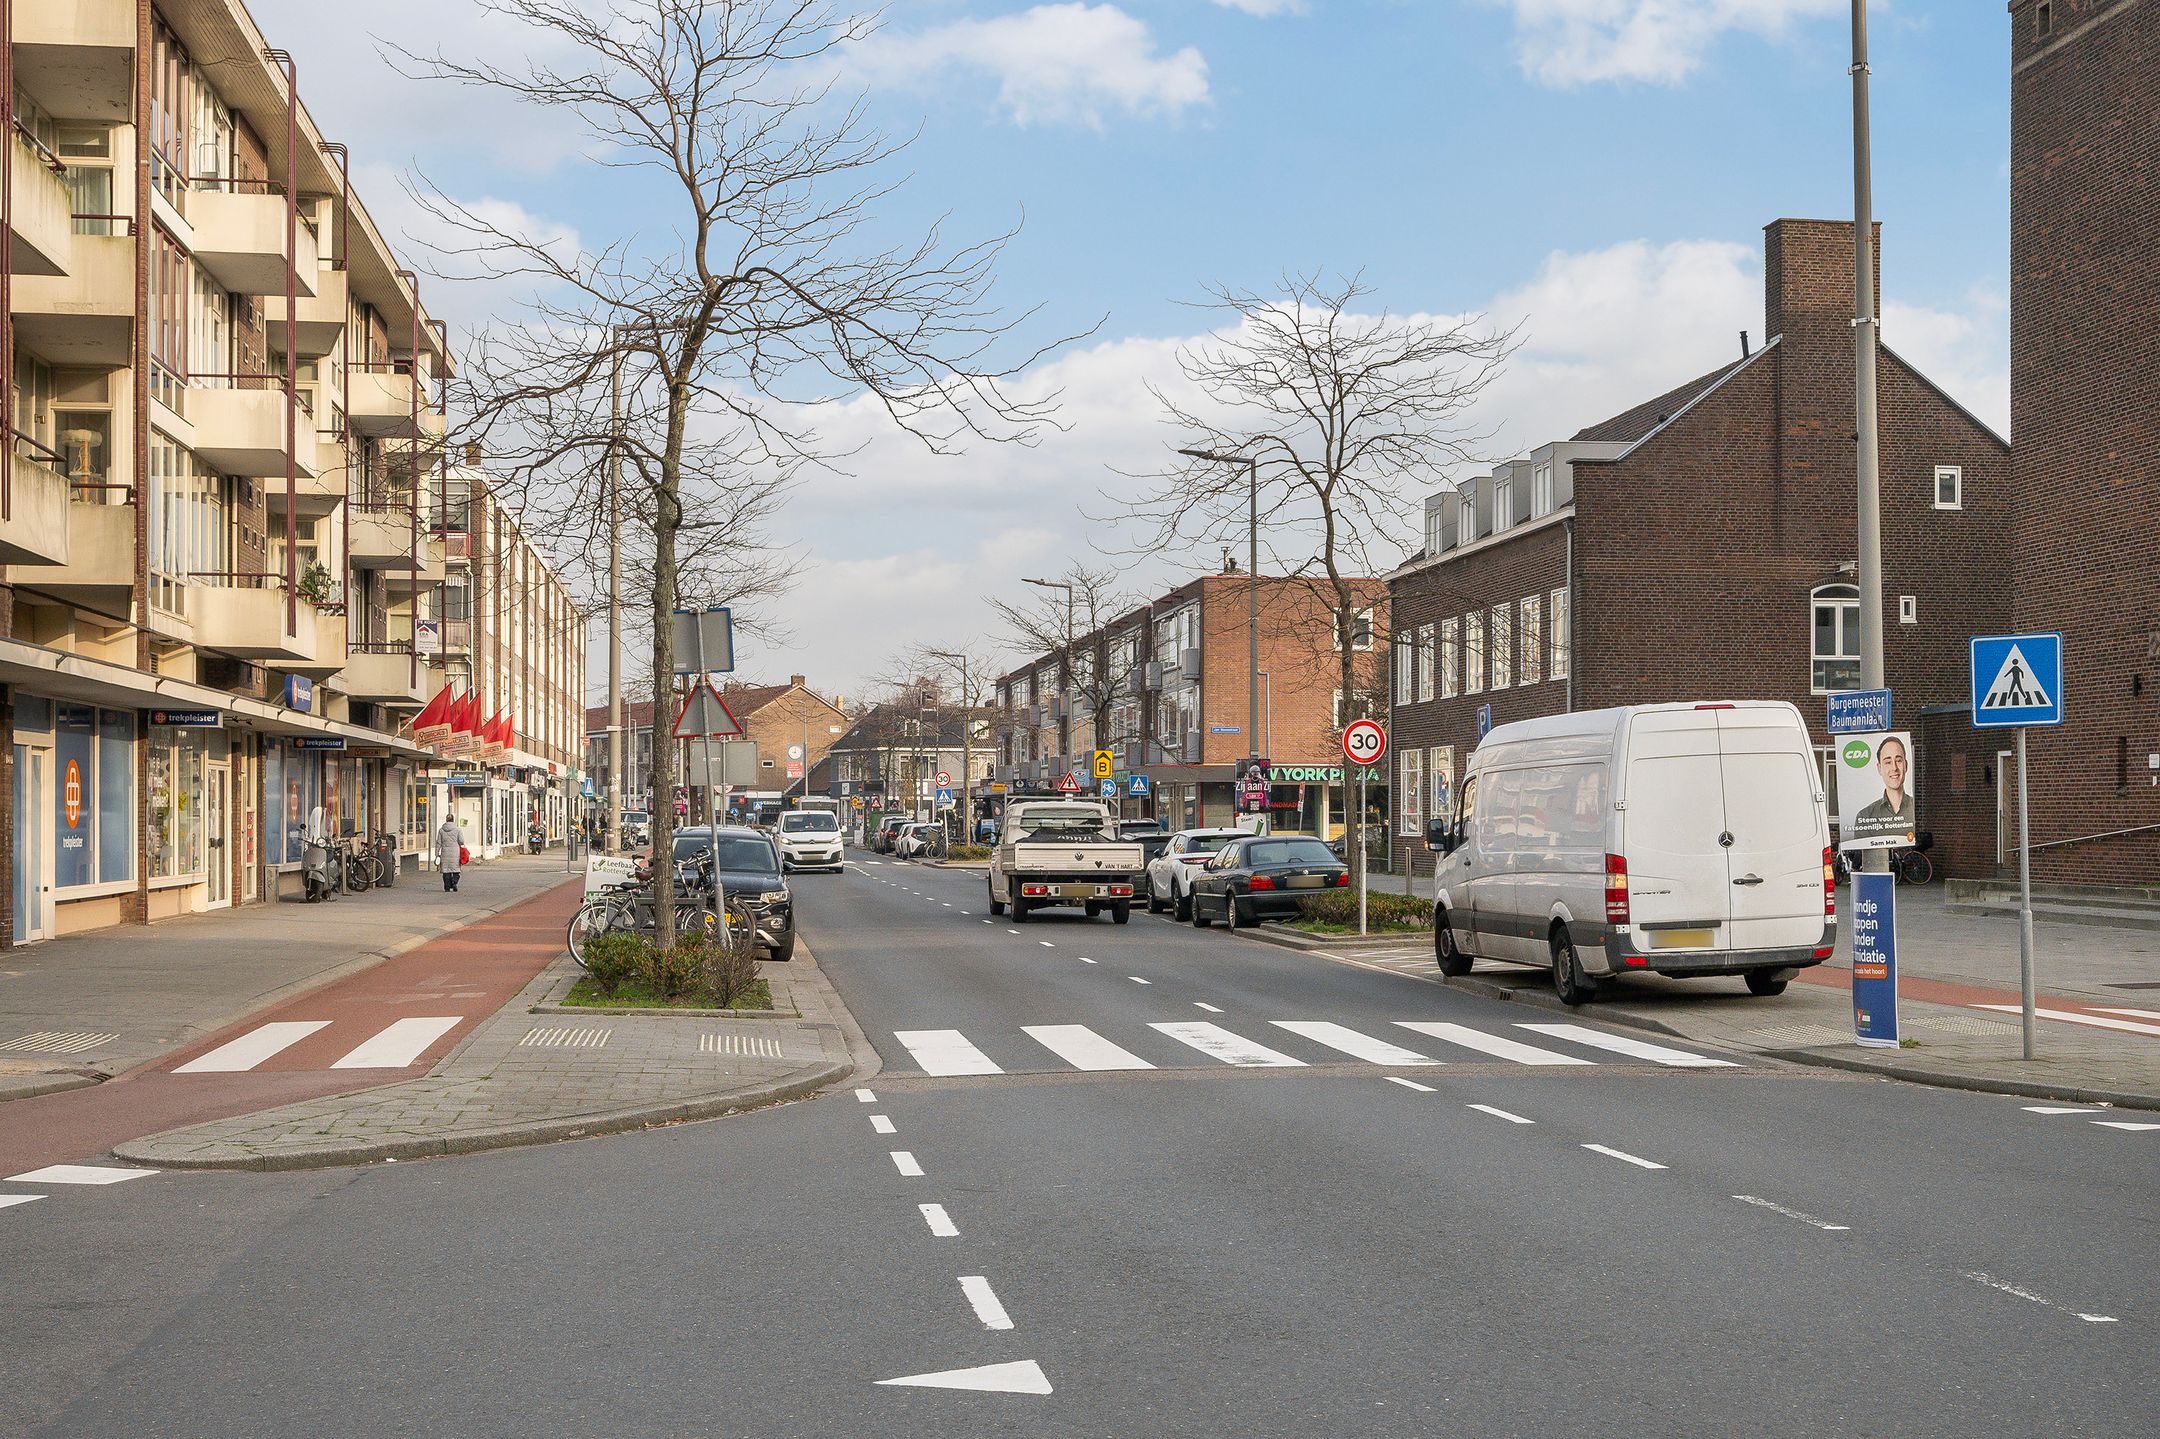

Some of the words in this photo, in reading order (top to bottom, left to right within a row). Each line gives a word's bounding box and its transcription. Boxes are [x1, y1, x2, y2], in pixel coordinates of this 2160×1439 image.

[1830, 696, 1885, 712] Burgemeester
[168, 714, 216, 723] trekpleister
[1480, 711, 1486, 735] P
[1831, 712, 1883, 727] Baumannlaan
[306, 739, 342, 748] trekpleister
[1351, 734, 1378, 750] 30
[1845, 750, 1869, 759] CDA
[1099, 763, 1107, 772] B
[1282, 768, 1328, 781] YORK
[1329, 768, 1380, 781] PIZA
[1236, 780, 1246, 793] Zij
[1247, 782, 1262, 791] aan
[1263, 780, 1272, 793] Zij
[1269, 801, 1298, 809] ANDMAD
[1844, 824, 1884, 832] fatsoenlijk
[1885, 821, 1914, 829] Rotterdam
[63, 834, 84, 850] trekpleister
[602, 867, 629, 875] Rotterda
[1855, 899, 1877, 916] ondje
